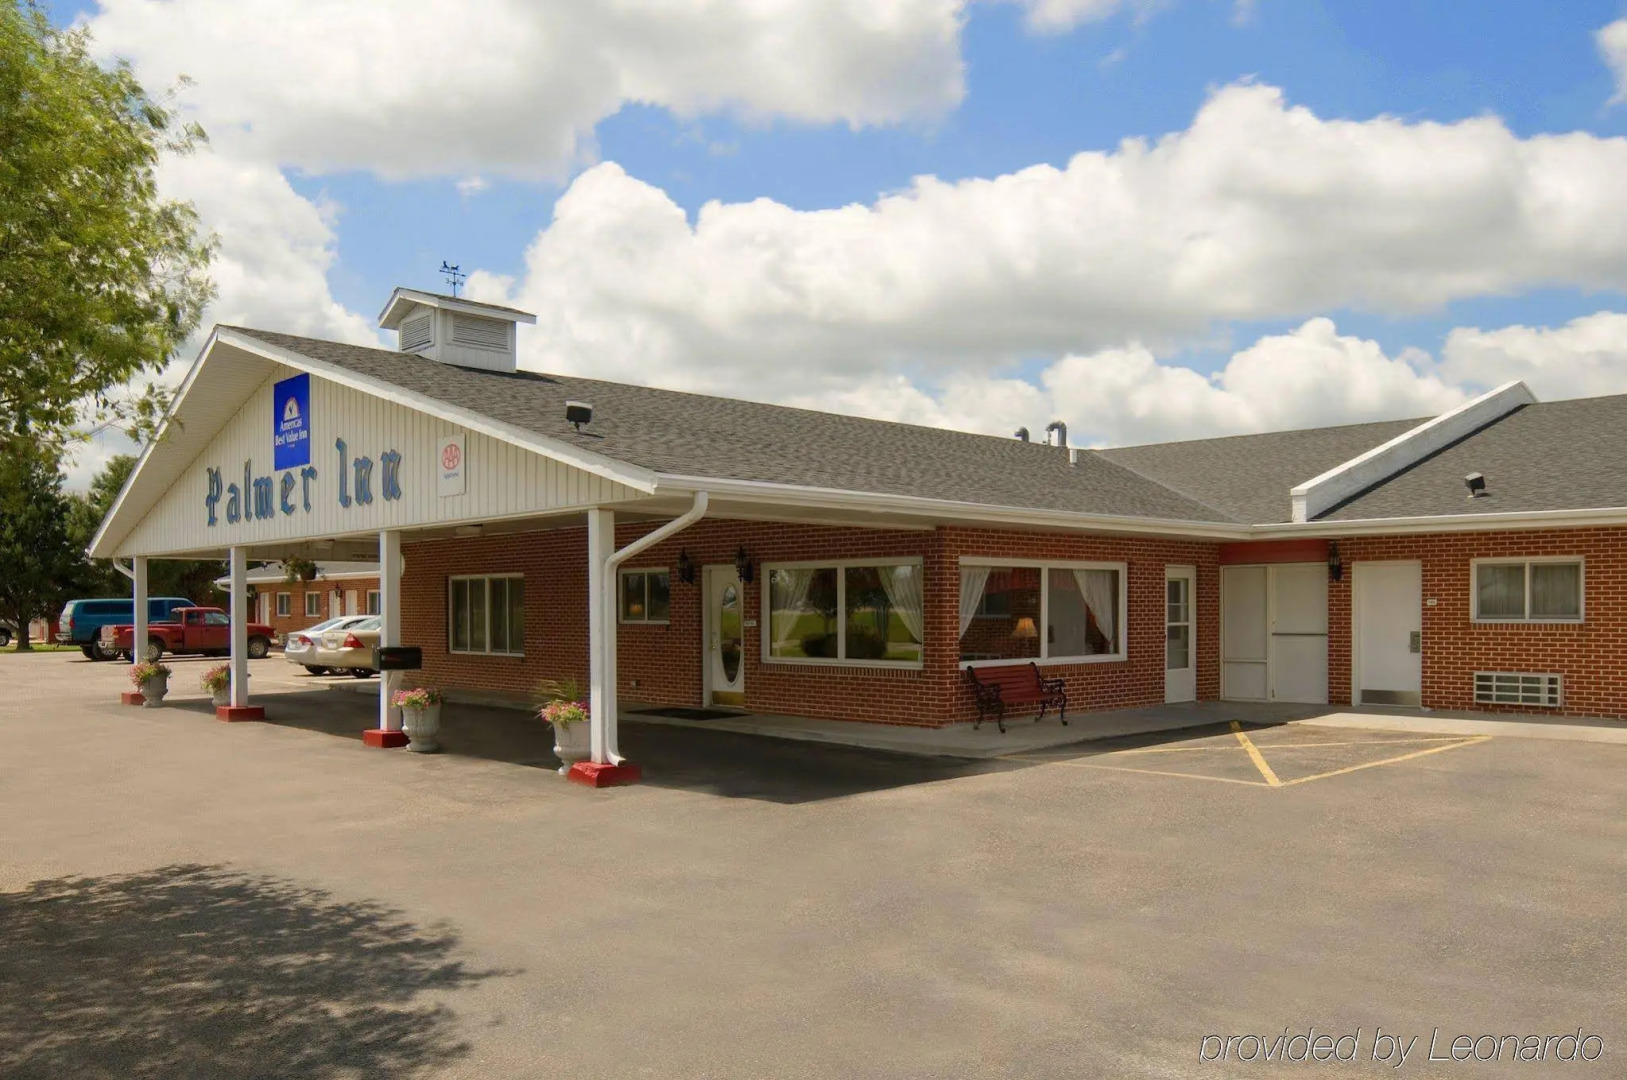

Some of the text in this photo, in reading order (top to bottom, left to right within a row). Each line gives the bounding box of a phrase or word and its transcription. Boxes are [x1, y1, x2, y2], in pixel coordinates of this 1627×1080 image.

[275, 434, 286, 446] Best
[286, 430, 298, 443] Value
[298, 428, 308, 440] Inn
[206, 458, 318, 527] Palmer
